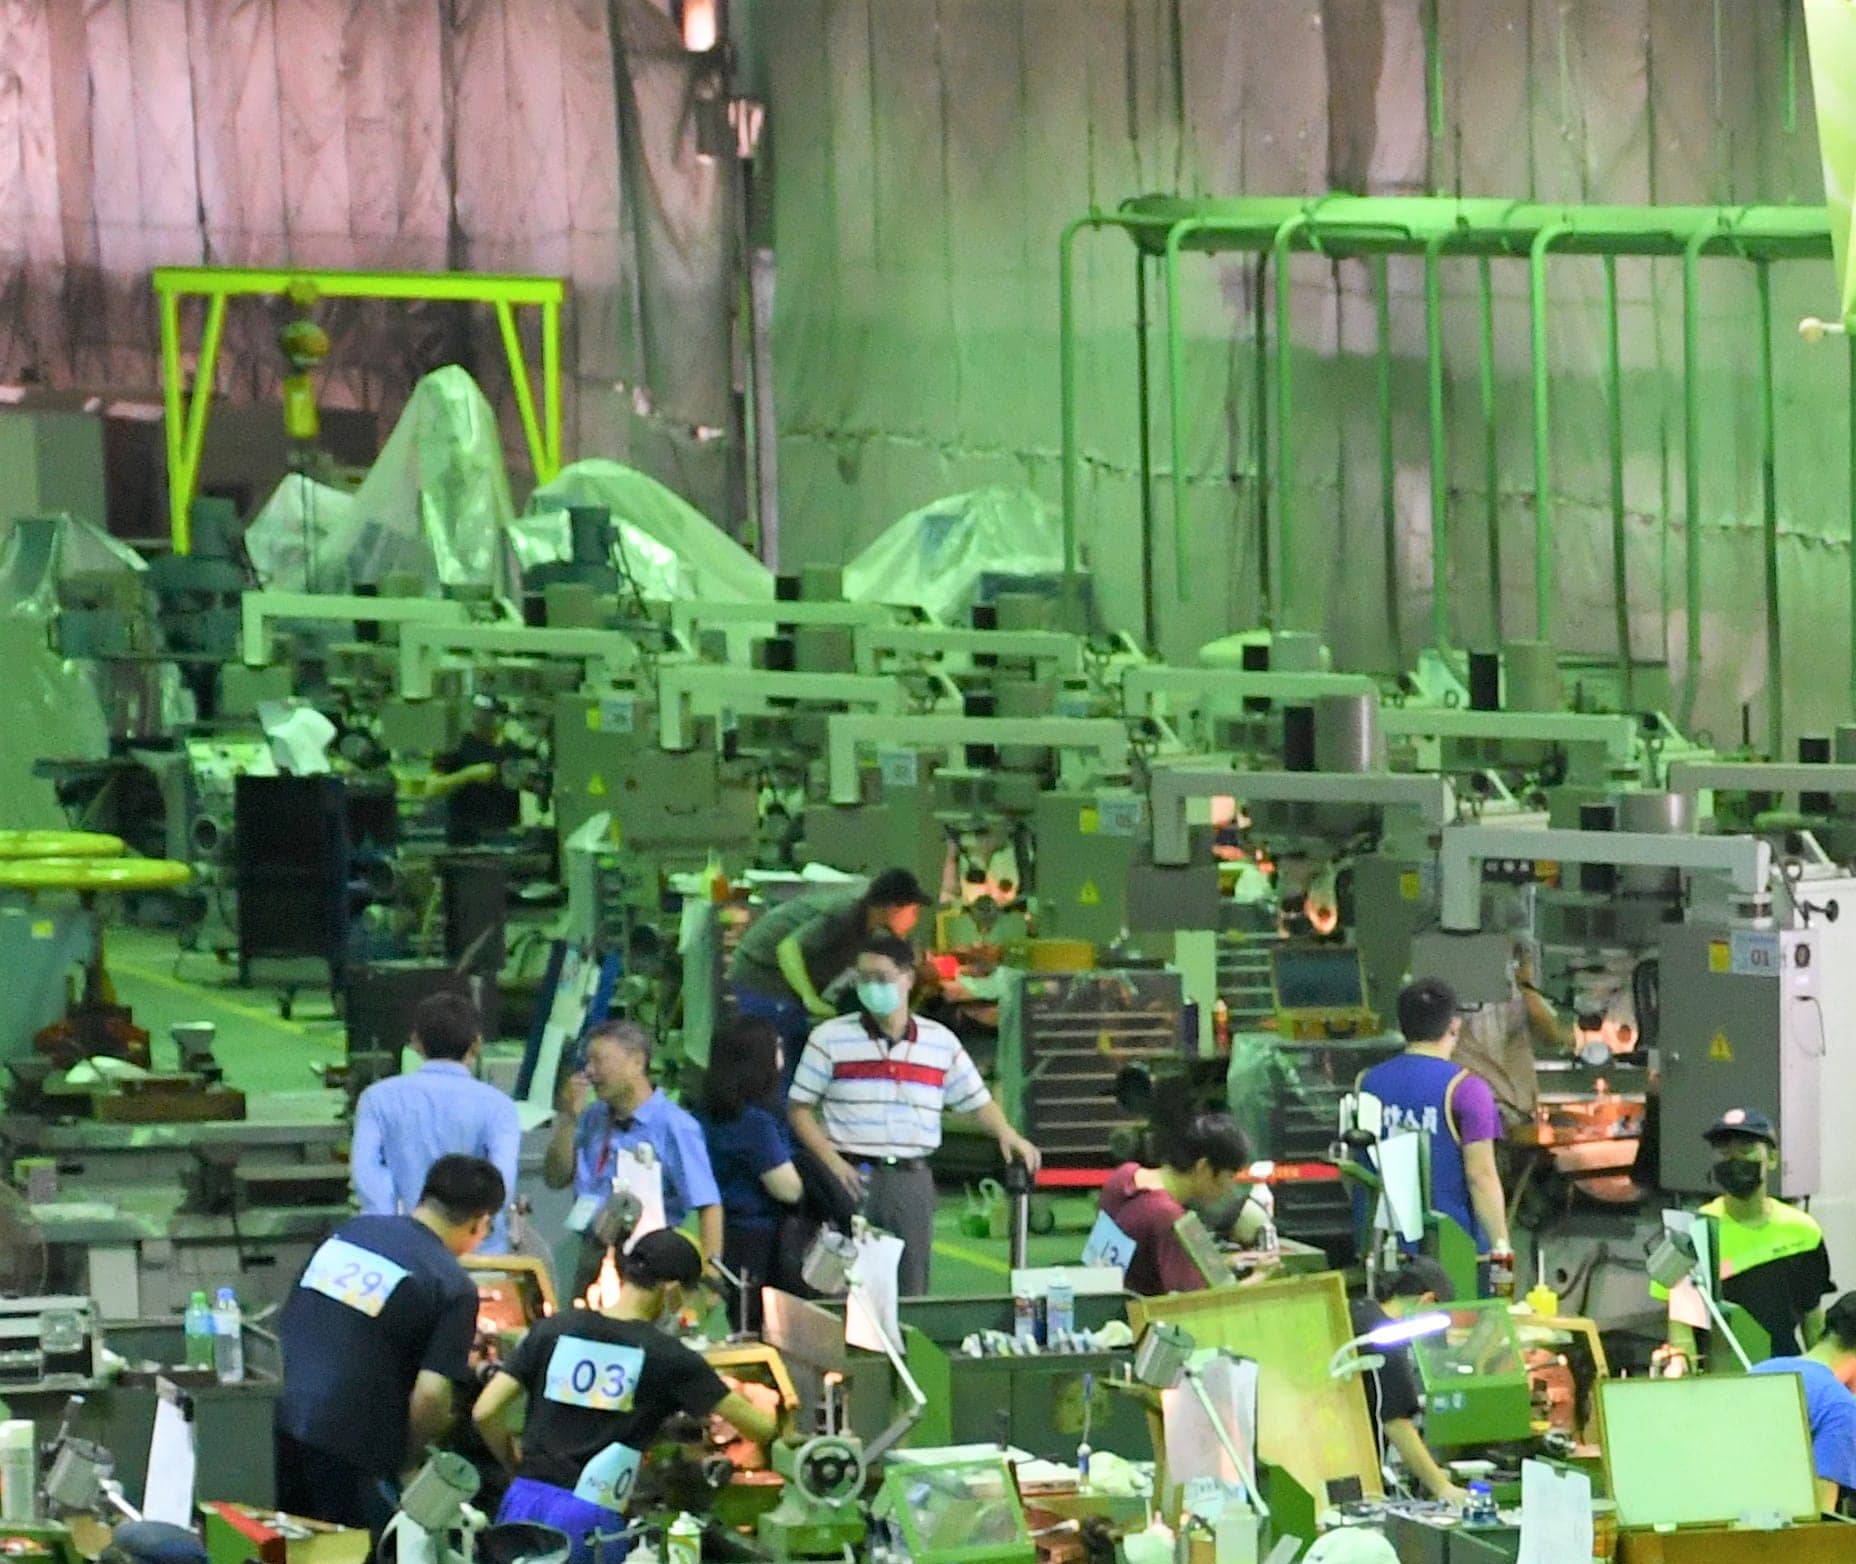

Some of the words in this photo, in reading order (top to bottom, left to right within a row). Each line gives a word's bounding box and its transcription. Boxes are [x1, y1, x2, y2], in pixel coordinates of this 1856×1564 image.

[1751, 949, 1770, 966] 01
[334, 1262, 383, 1297] 29
[571, 1359, 626, 1398] 03
